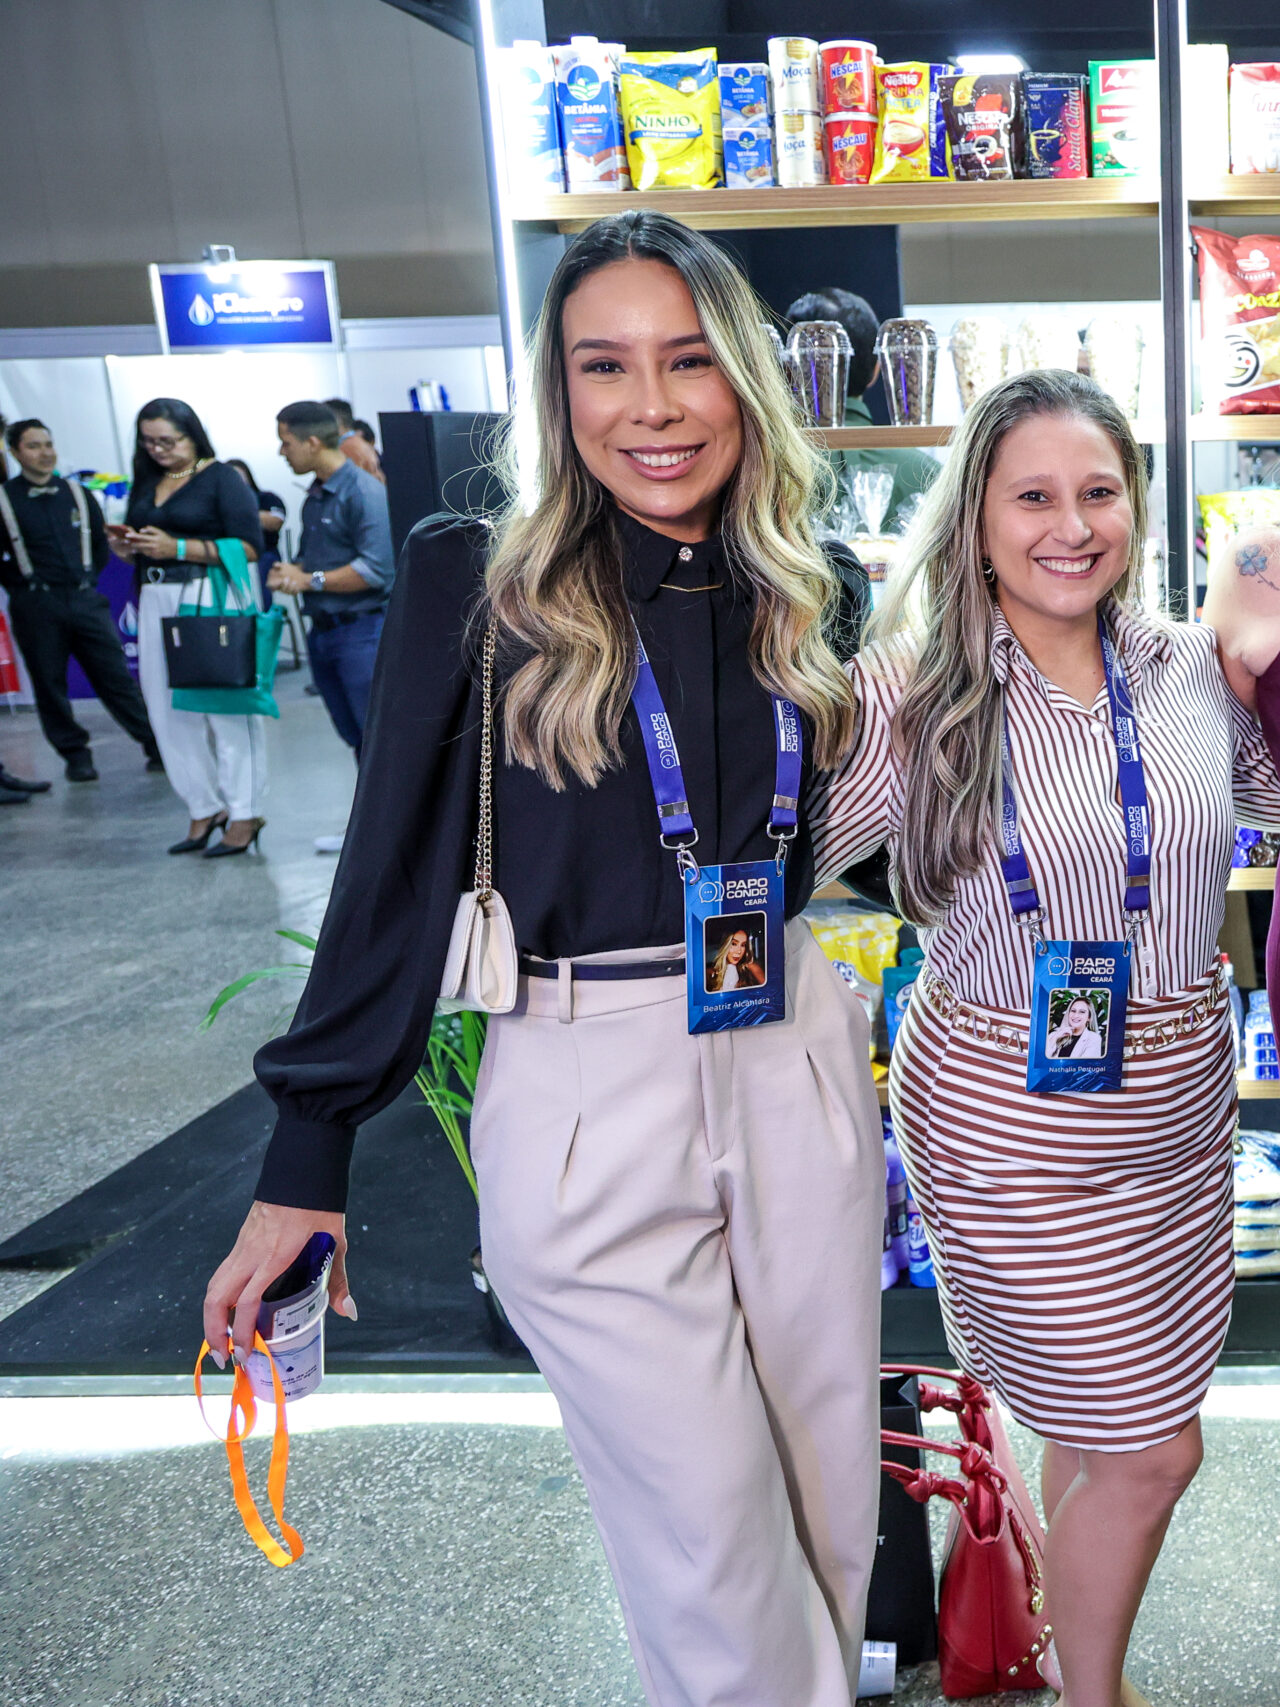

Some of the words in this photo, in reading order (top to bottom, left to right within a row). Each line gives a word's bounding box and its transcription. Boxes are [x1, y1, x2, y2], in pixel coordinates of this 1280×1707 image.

[564, 102, 608, 115] BETÂNIA
[1065, 89, 1080, 129] Clara
[635, 115, 690, 128] NINHO
[833, 133, 867, 151] NESCAU
[1068, 132, 1081, 171] Santa
[650, 713, 667, 750] PAPO
[657, 712, 673, 748] CONDO
[784, 717, 793, 752] CONDO
[789, 717, 798, 753] PAPO
[1116, 716, 1125, 746] PAPO
[1128, 806, 1136, 838] PAPO
[1134, 805, 1142, 838] CONDO
[1008, 821, 1020, 855] PAPO
[726, 878, 768, 890] PAPO
[726, 888, 768, 899] CONDO
[744, 896, 767, 906] CEARÁ
[1074, 958, 1116, 967] PAPO
[1074, 967, 1115, 975] CONDO
[1090, 975, 1113, 983] CEARÁ
[703, 1002, 731, 1013] Beatriz
